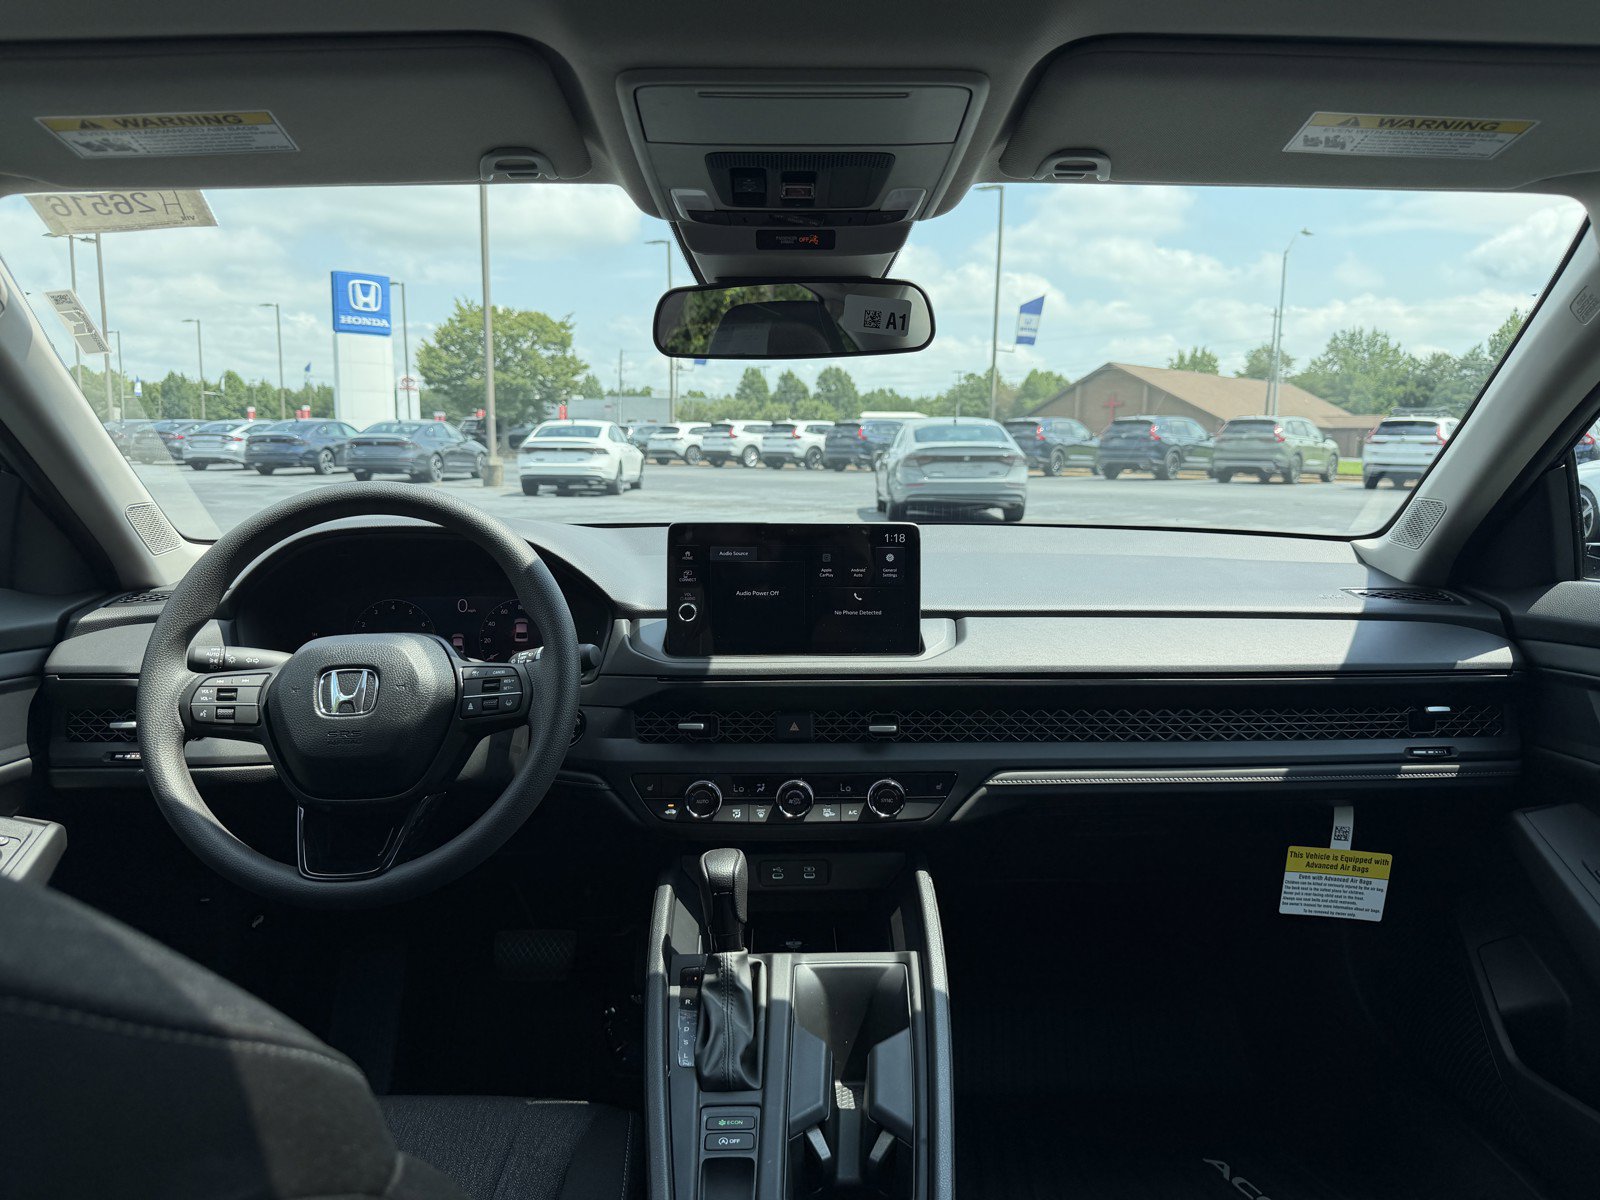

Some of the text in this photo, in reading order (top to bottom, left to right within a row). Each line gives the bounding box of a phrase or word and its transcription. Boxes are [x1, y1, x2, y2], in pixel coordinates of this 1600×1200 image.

[112, 114, 243, 129] WARNING
[1377, 117, 1501, 131] WARNING
[339, 314, 391, 328] HONDA
[885, 311, 907, 331] A1
[884, 533, 906, 543] 1:18
[1289, 850, 1390, 866] This Vehicle is Equipped with
[1305, 861, 1370, 874] Advanced Air Bags
[1358, 878, 1373, 886] Bags
